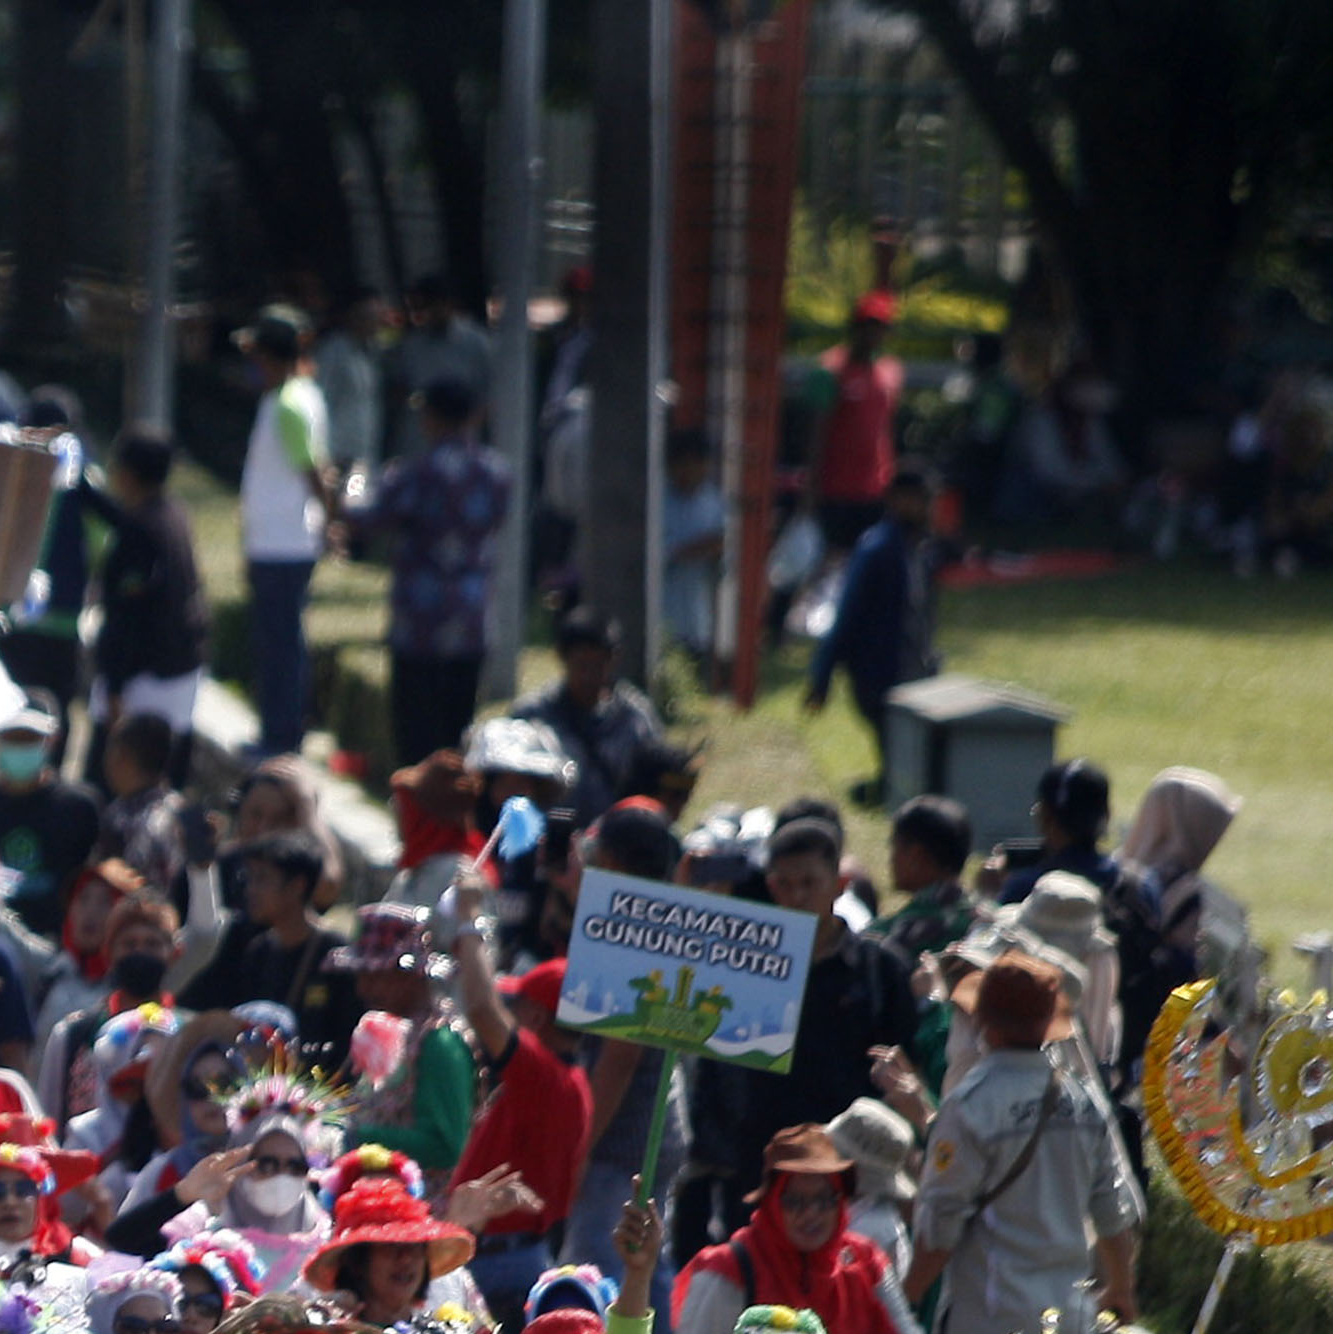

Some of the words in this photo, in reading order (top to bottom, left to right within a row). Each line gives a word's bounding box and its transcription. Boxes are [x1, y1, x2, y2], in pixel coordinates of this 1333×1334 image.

[584, 916, 704, 961] GUNUNG
[708, 941, 792, 981] PUTRI
[610, 891, 782, 950] KECAMATAN
